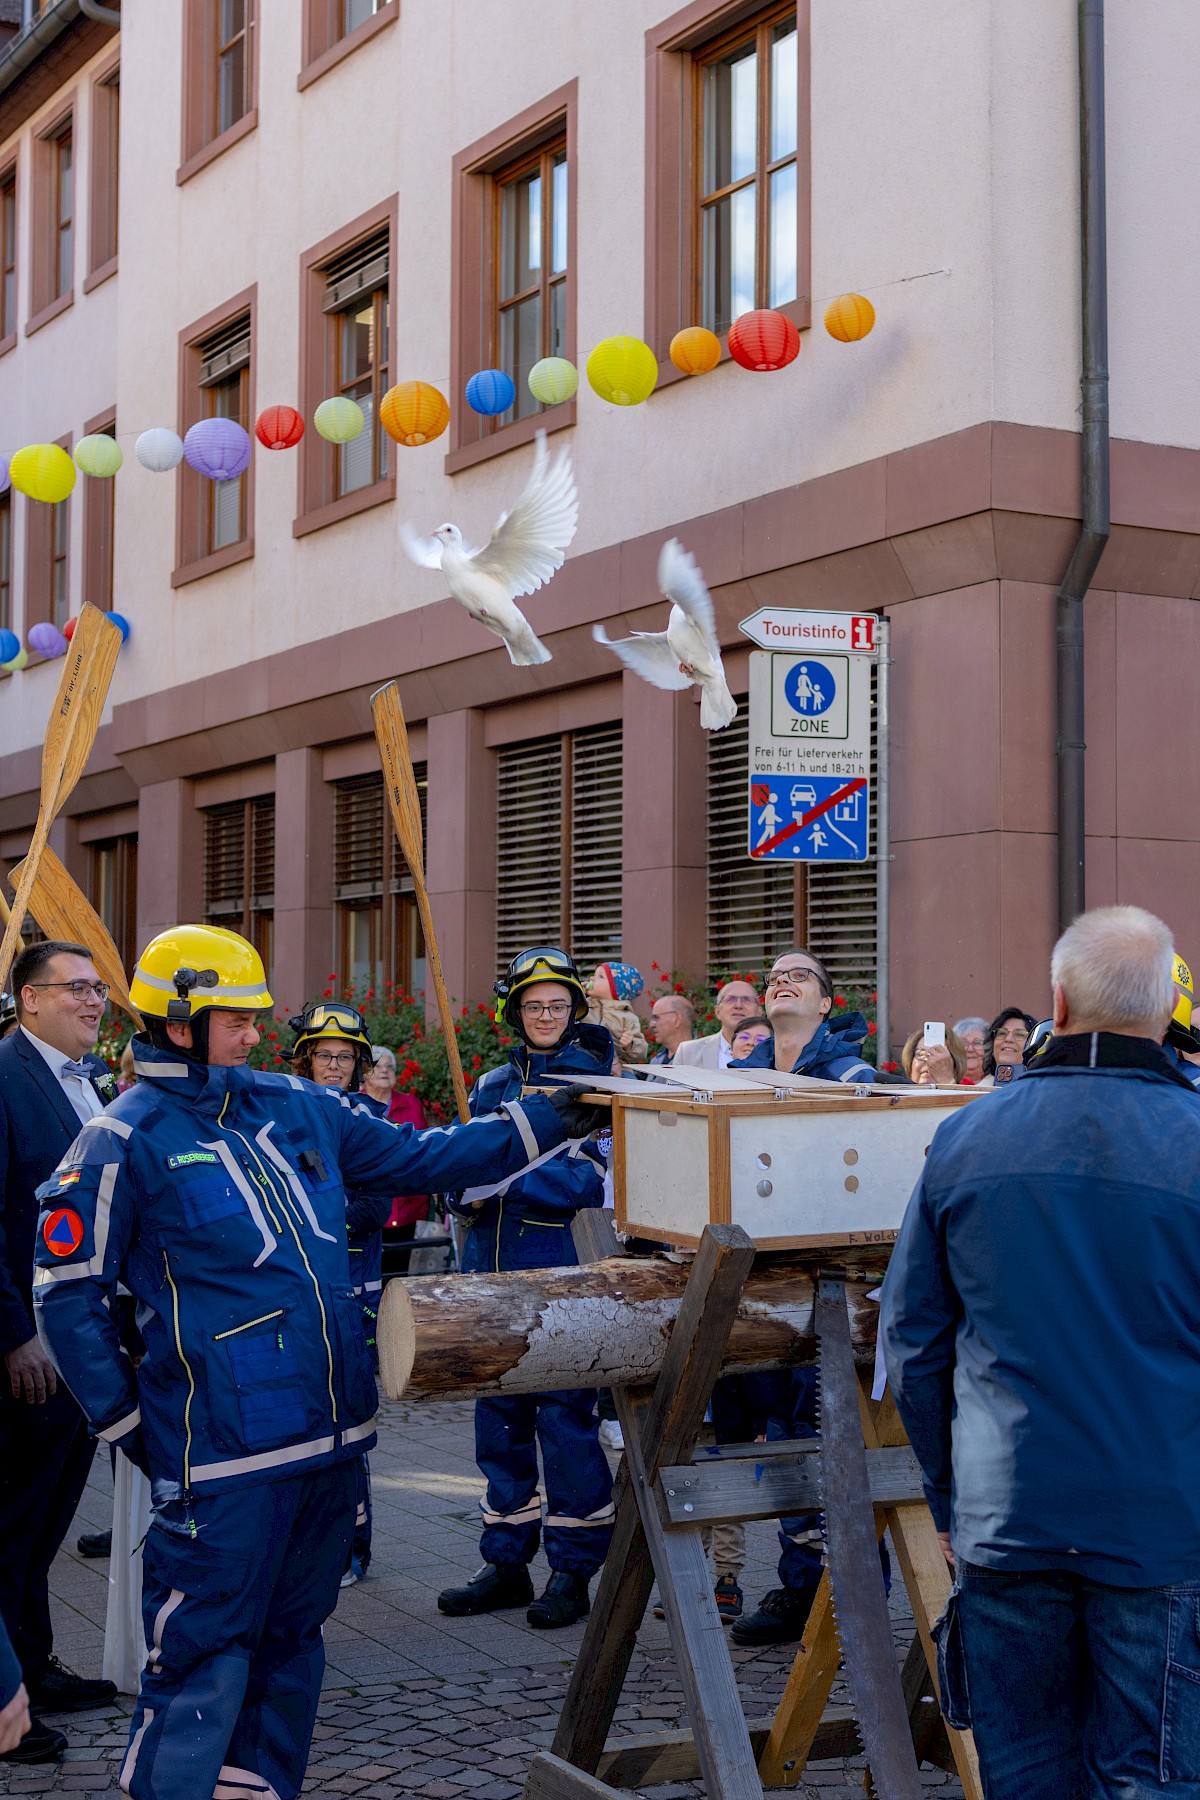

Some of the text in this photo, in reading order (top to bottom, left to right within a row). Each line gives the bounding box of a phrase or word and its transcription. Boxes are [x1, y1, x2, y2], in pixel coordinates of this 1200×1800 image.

[763, 621, 846, 639] Touristinfo
[791, 718, 829, 734] ZONE
[755, 747, 863, 760] Frei für Lieferverkehr
[755, 762, 865, 774] von 6-11 h und 18-21 h
[170, 1157, 178, 1167] C.
